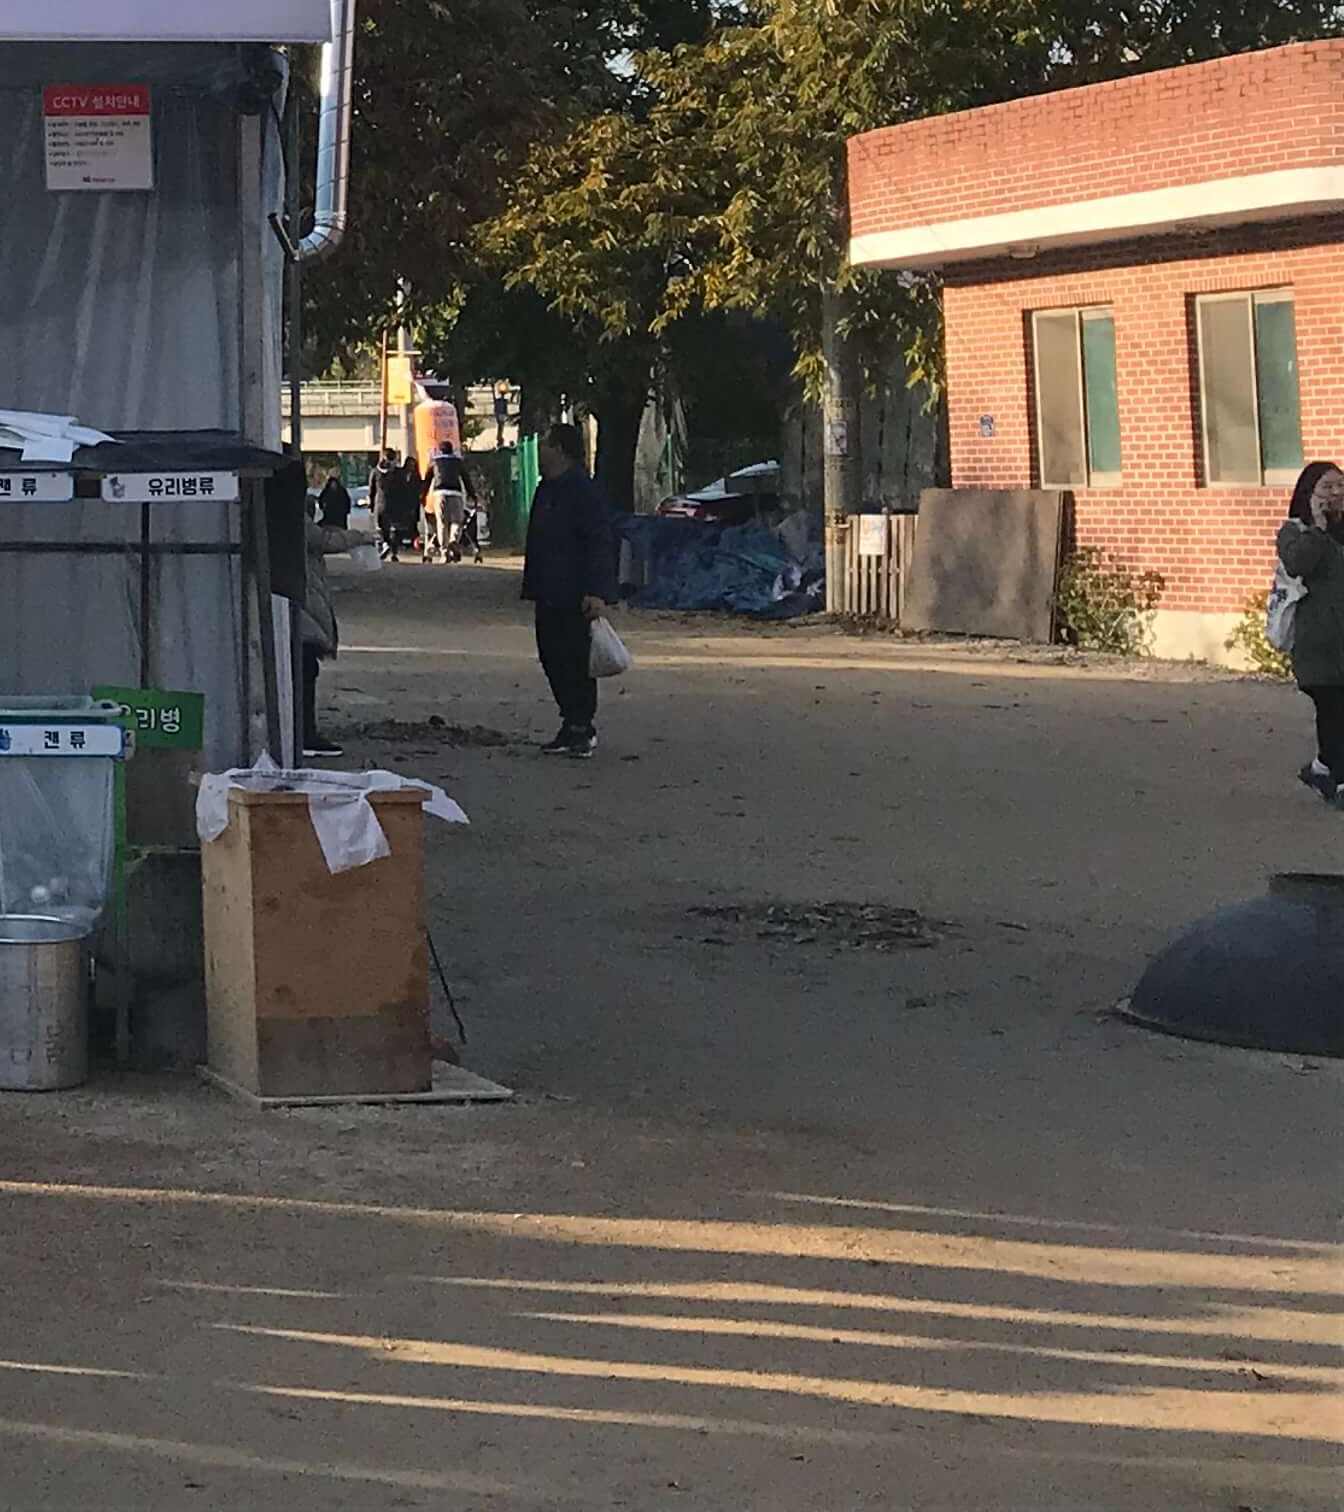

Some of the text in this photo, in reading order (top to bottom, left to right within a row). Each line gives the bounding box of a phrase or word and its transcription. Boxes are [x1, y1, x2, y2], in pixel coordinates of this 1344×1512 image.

[52, 96, 89, 109] CCTV
[148, 477, 215, 497] 유리병류
[120, 704, 181, 733] 리병
